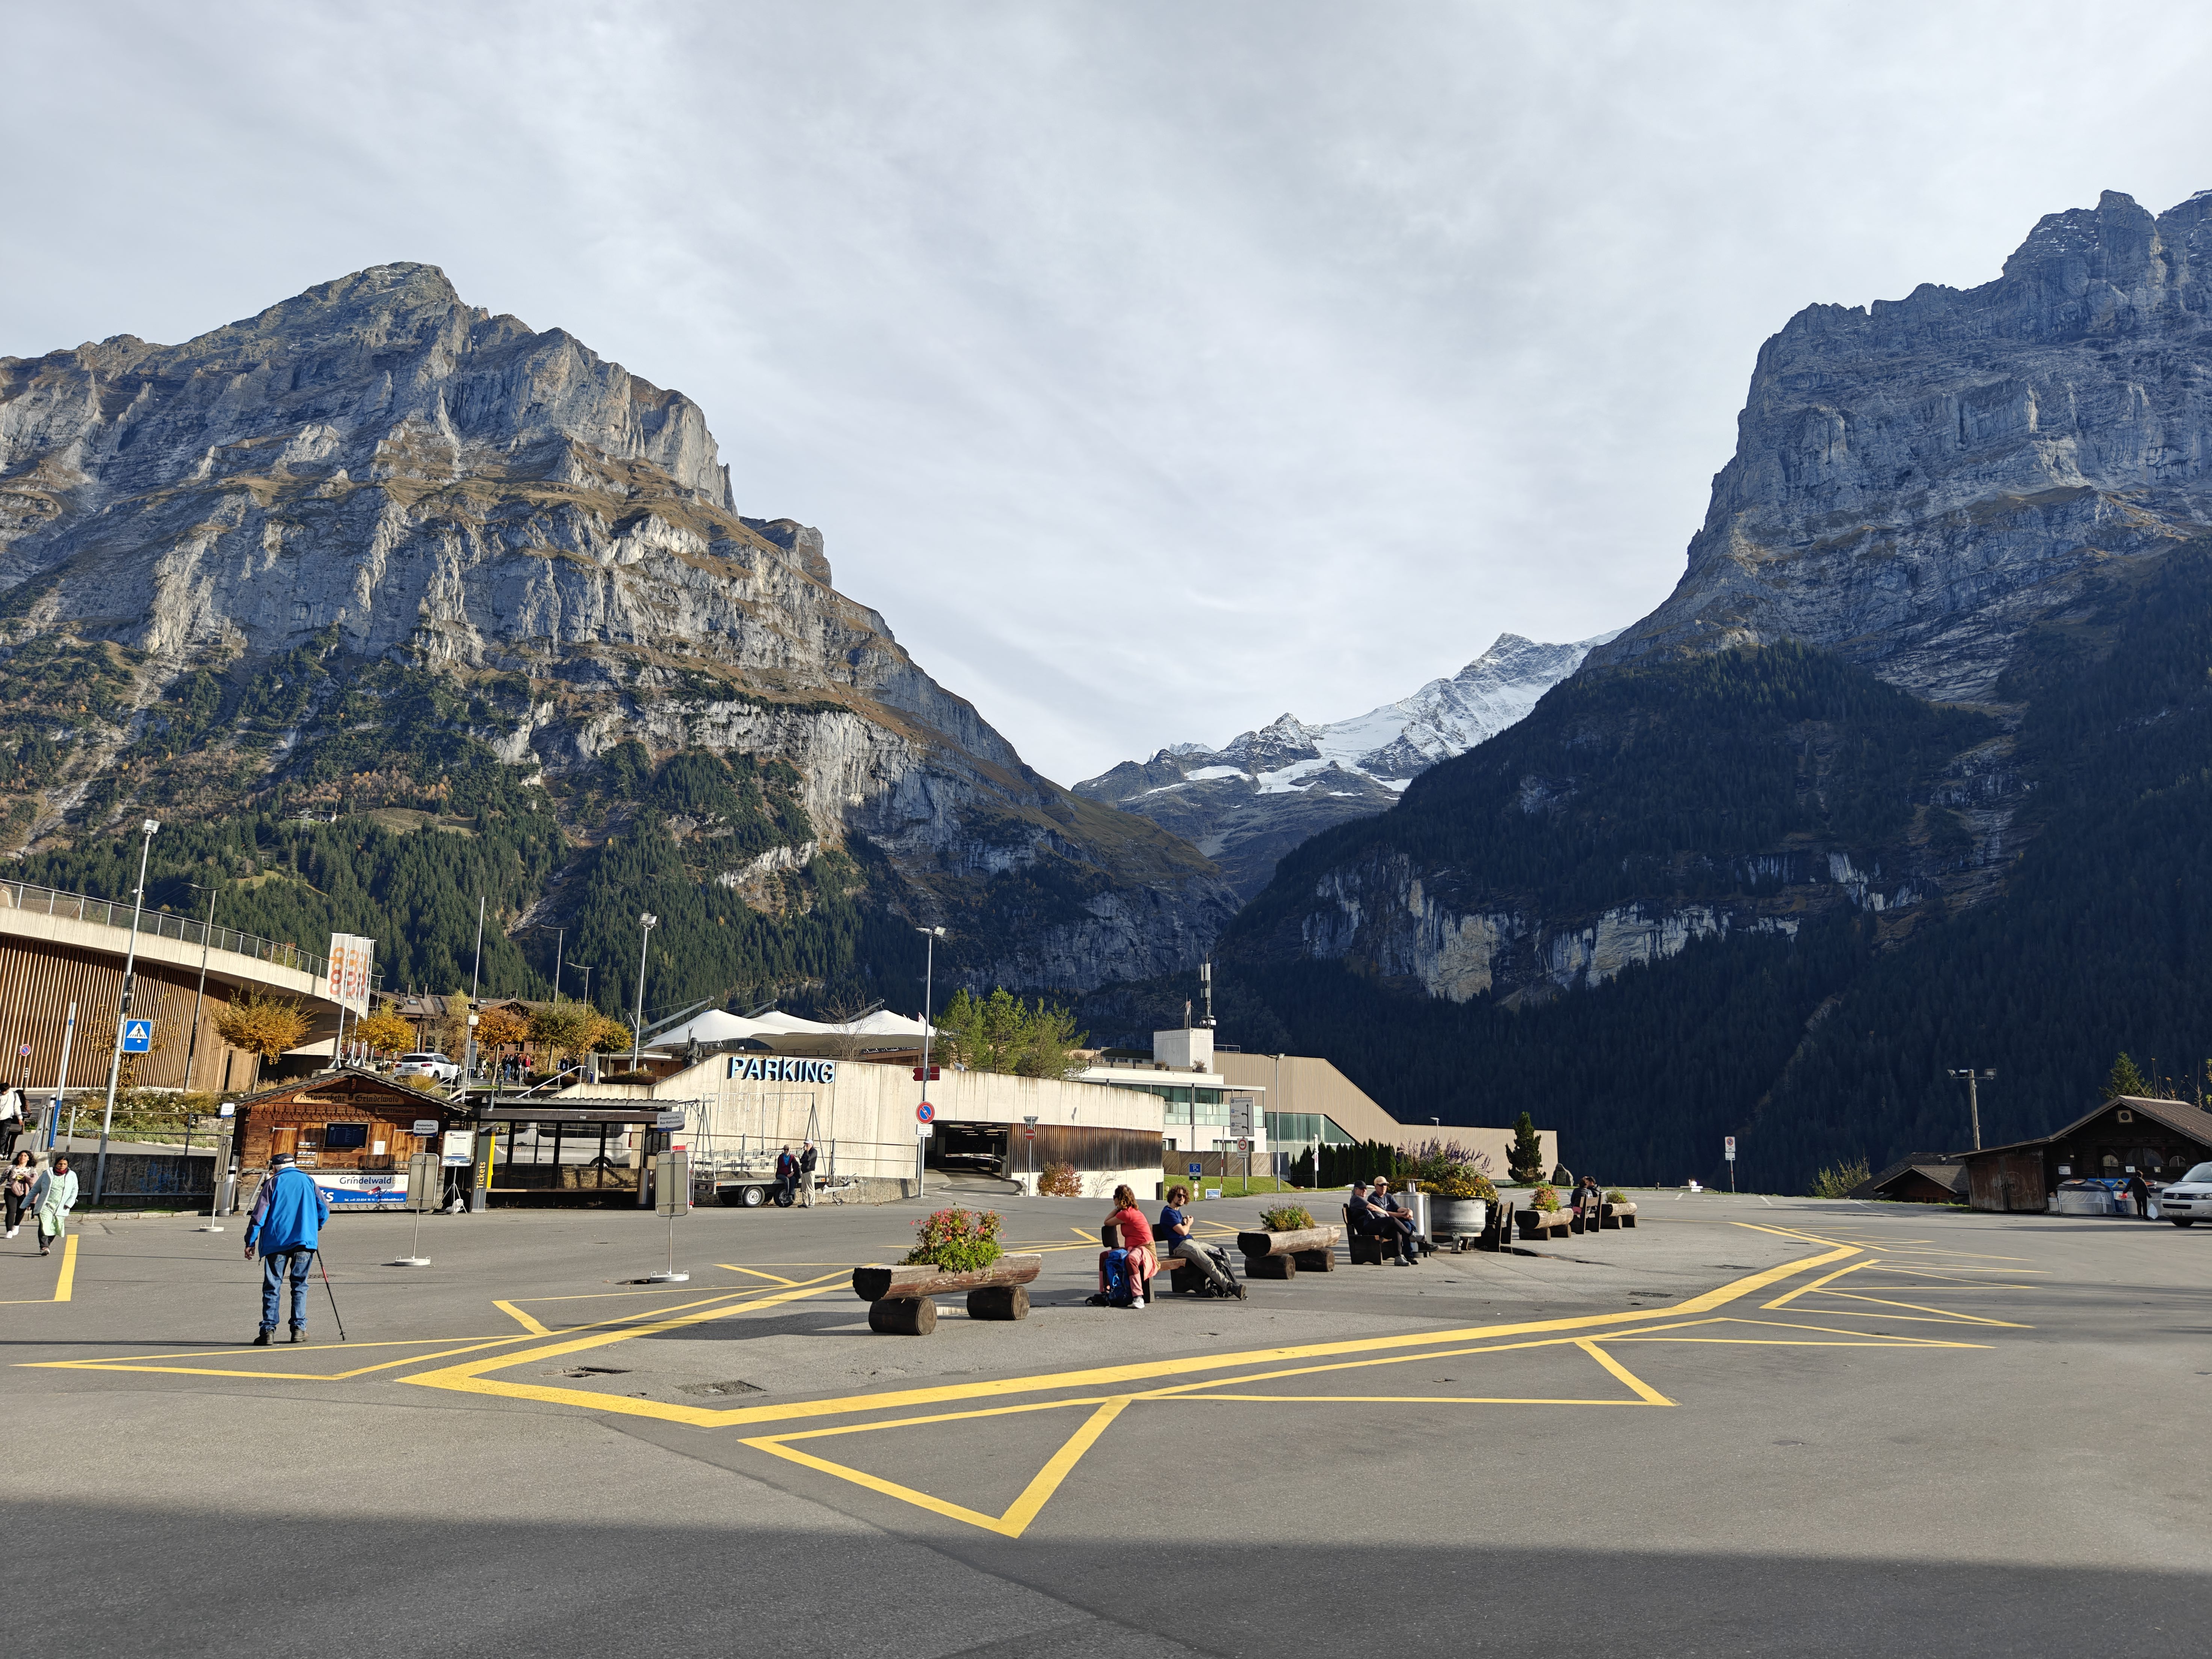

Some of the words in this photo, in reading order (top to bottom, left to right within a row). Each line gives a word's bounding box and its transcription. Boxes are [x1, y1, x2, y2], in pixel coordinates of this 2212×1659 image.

[729, 1057, 835, 1083] PARKING
[299, 1093, 346, 1102] Autoverkehr
[476, 1162, 486, 1189] Tickets
